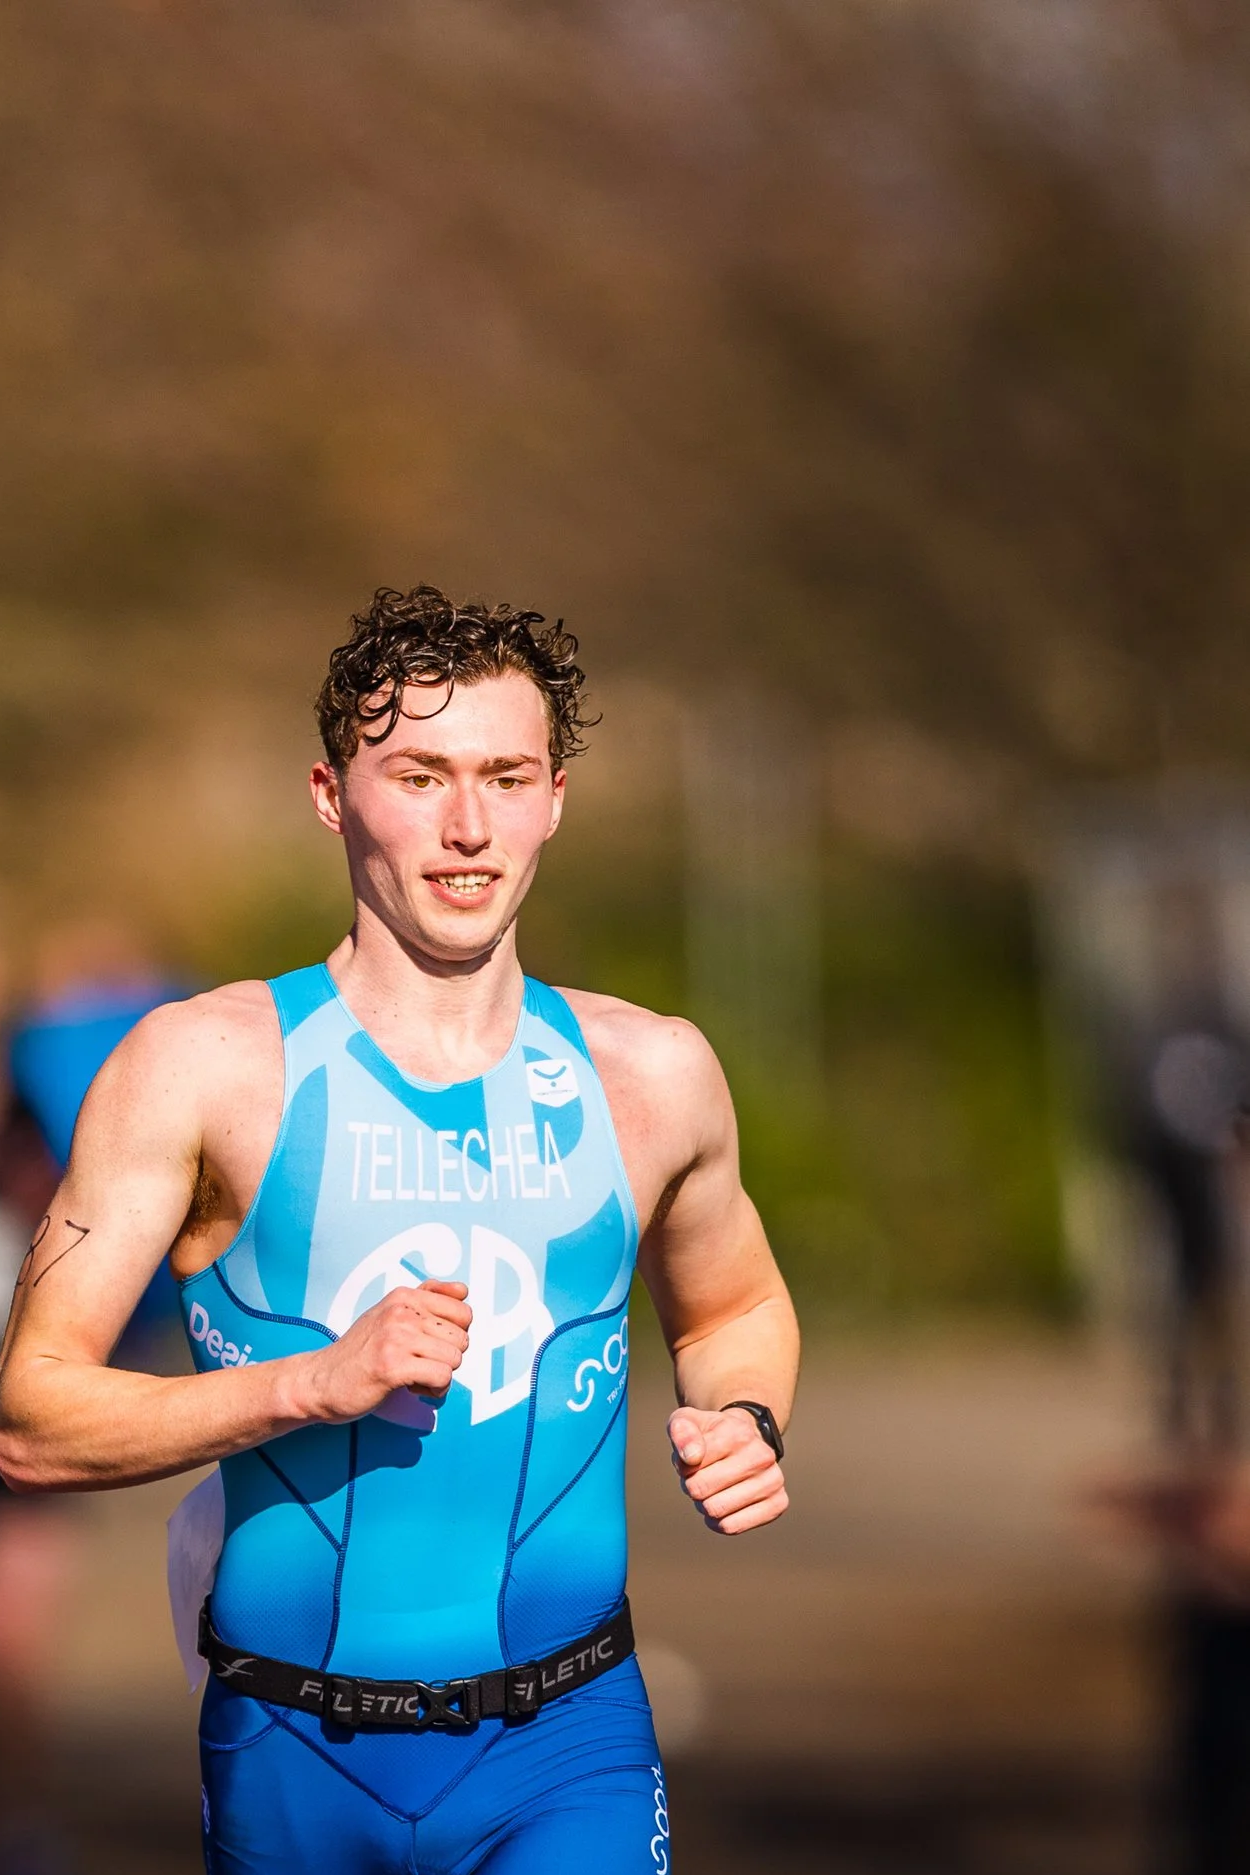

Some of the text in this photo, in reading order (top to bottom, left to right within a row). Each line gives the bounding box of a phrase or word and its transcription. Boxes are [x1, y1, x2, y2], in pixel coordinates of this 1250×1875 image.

[347, 1120, 572, 1202] TELLECHEA
[16, 1214, 91, 1287] 87
[188, 1301, 258, 1369] Desi
